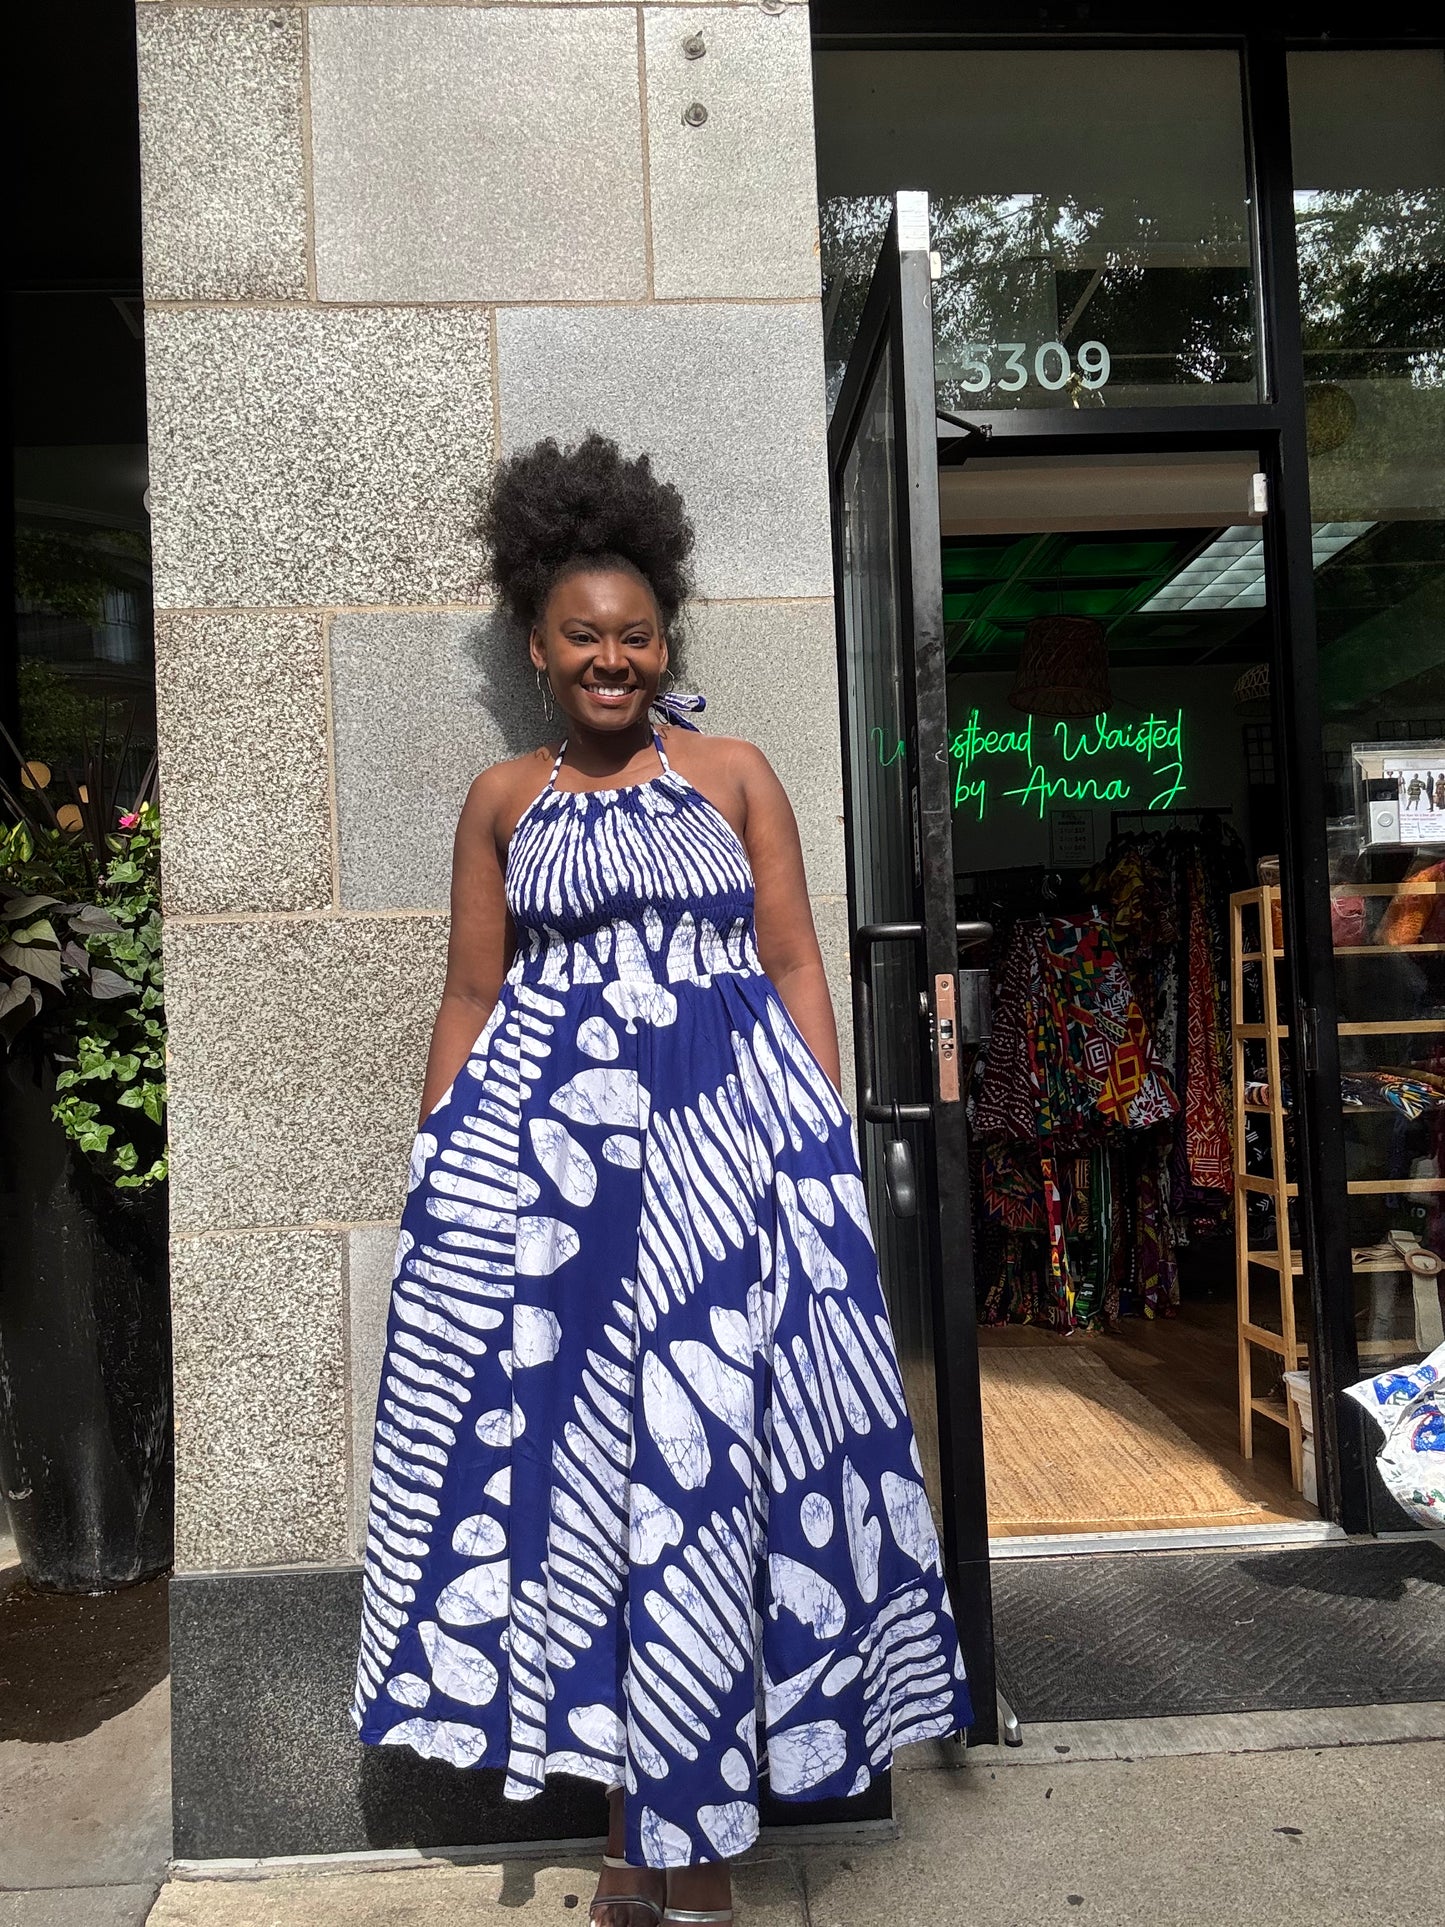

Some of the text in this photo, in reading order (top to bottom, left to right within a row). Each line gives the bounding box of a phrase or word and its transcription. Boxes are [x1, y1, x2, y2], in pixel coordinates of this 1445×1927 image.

[960, 340, 1111, 392] 5309
[1055, 708, 1183, 762] Waisted
[954, 763, 986, 822] by
[1002, 765, 1131, 819] Anna
